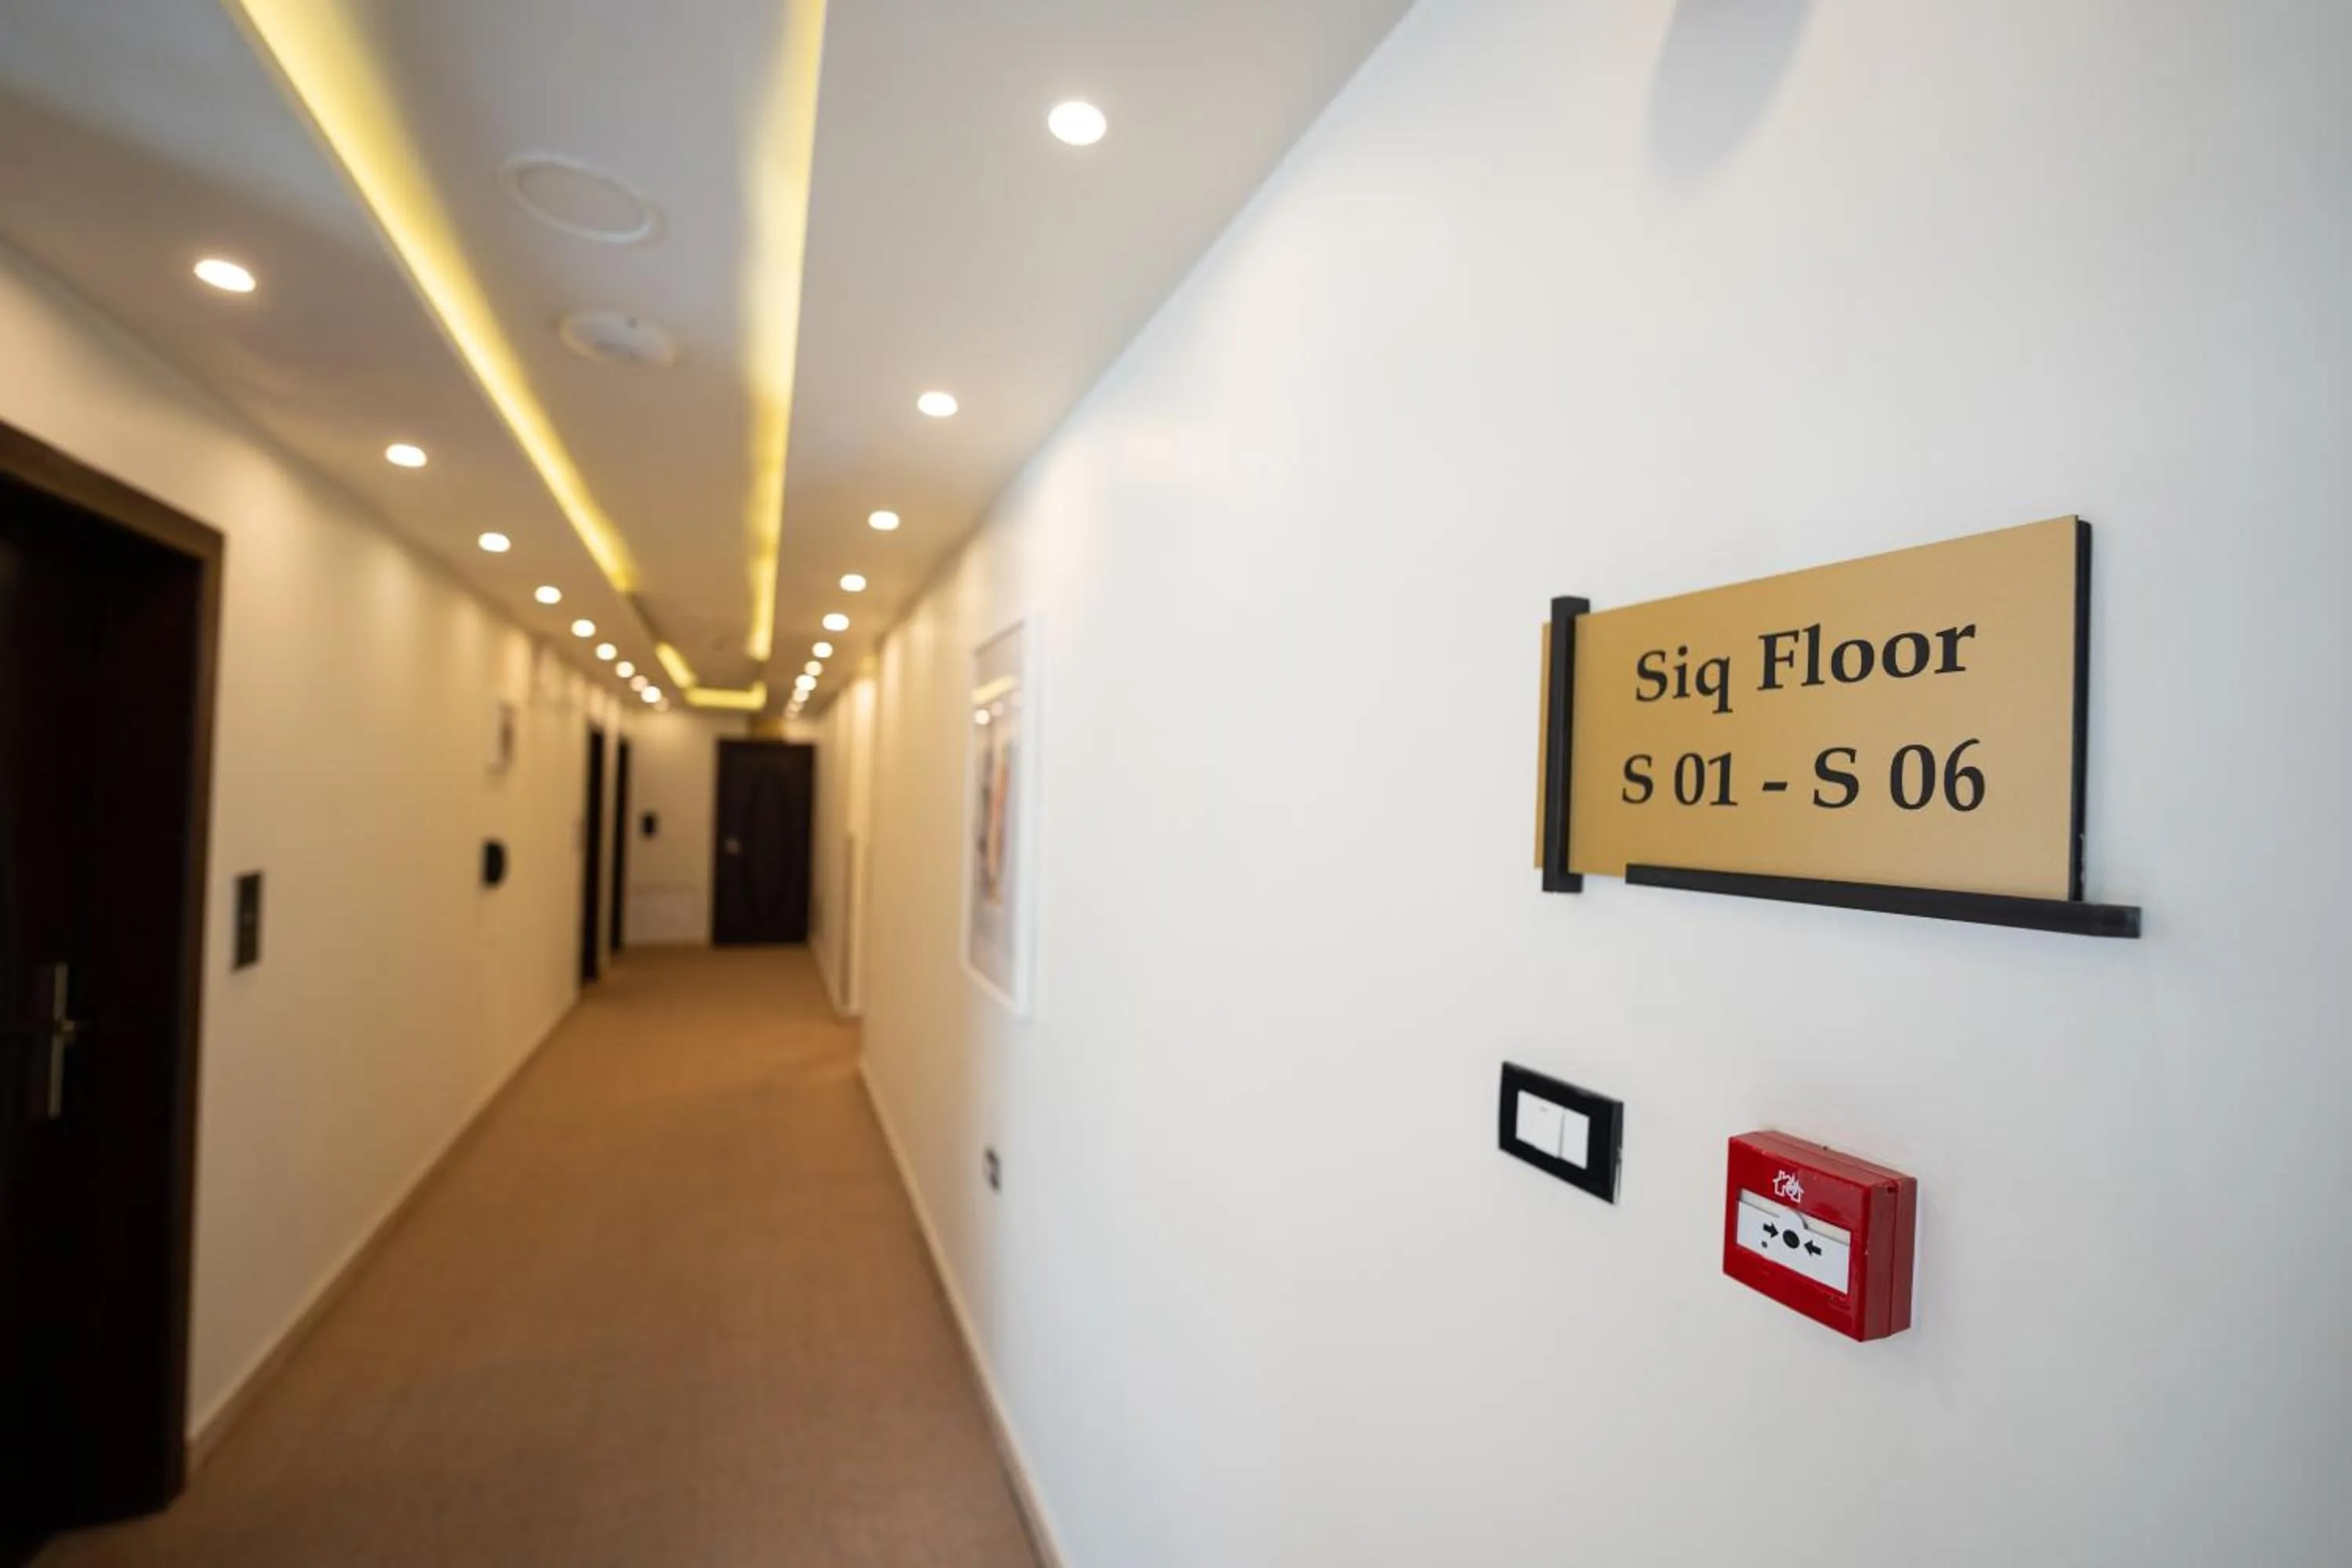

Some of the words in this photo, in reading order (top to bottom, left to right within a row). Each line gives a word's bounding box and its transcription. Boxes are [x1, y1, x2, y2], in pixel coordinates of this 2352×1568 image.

[1635, 644, 1734, 715] Siq
[1756, 622, 1977, 691] Floor
[1621, 753, 1655, 806] S
[1673, 751, 1739, 808] 01
[1812, 746, 1860, 810] S
[1889, 737, 1986, 813] 06
